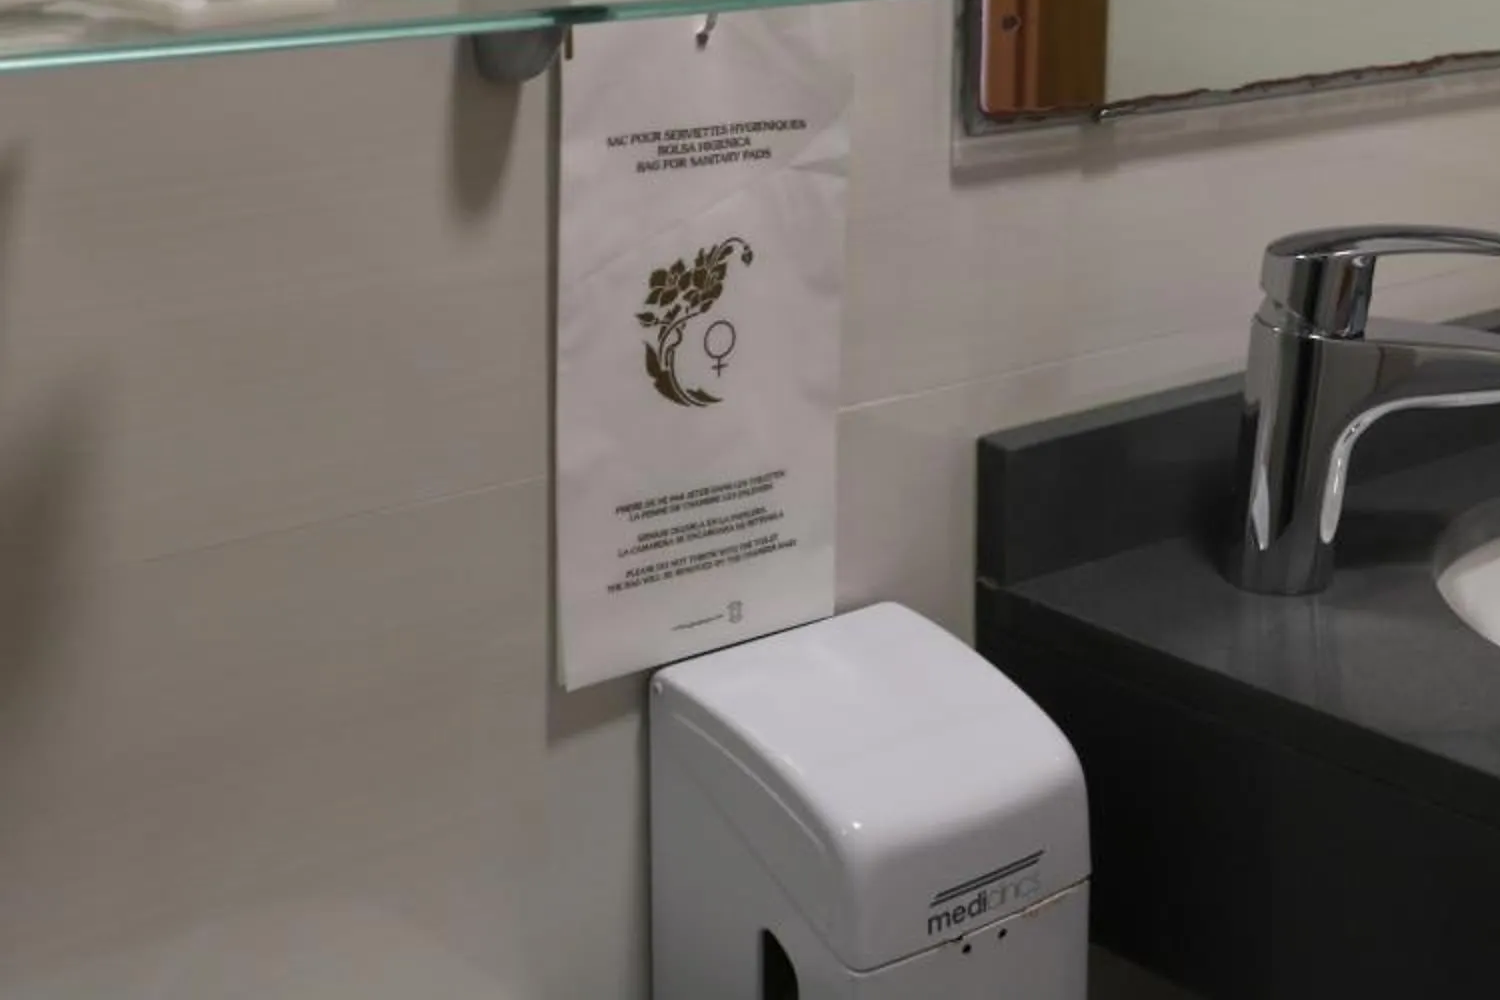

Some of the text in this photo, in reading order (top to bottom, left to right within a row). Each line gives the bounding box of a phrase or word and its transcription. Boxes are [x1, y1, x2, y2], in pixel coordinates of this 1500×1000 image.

[630, 131, 662, 145] POUR
[657, 142, 696, 157] BOLSA
[636, 147, 772, 173] BAG FOR SANITARY PADS
